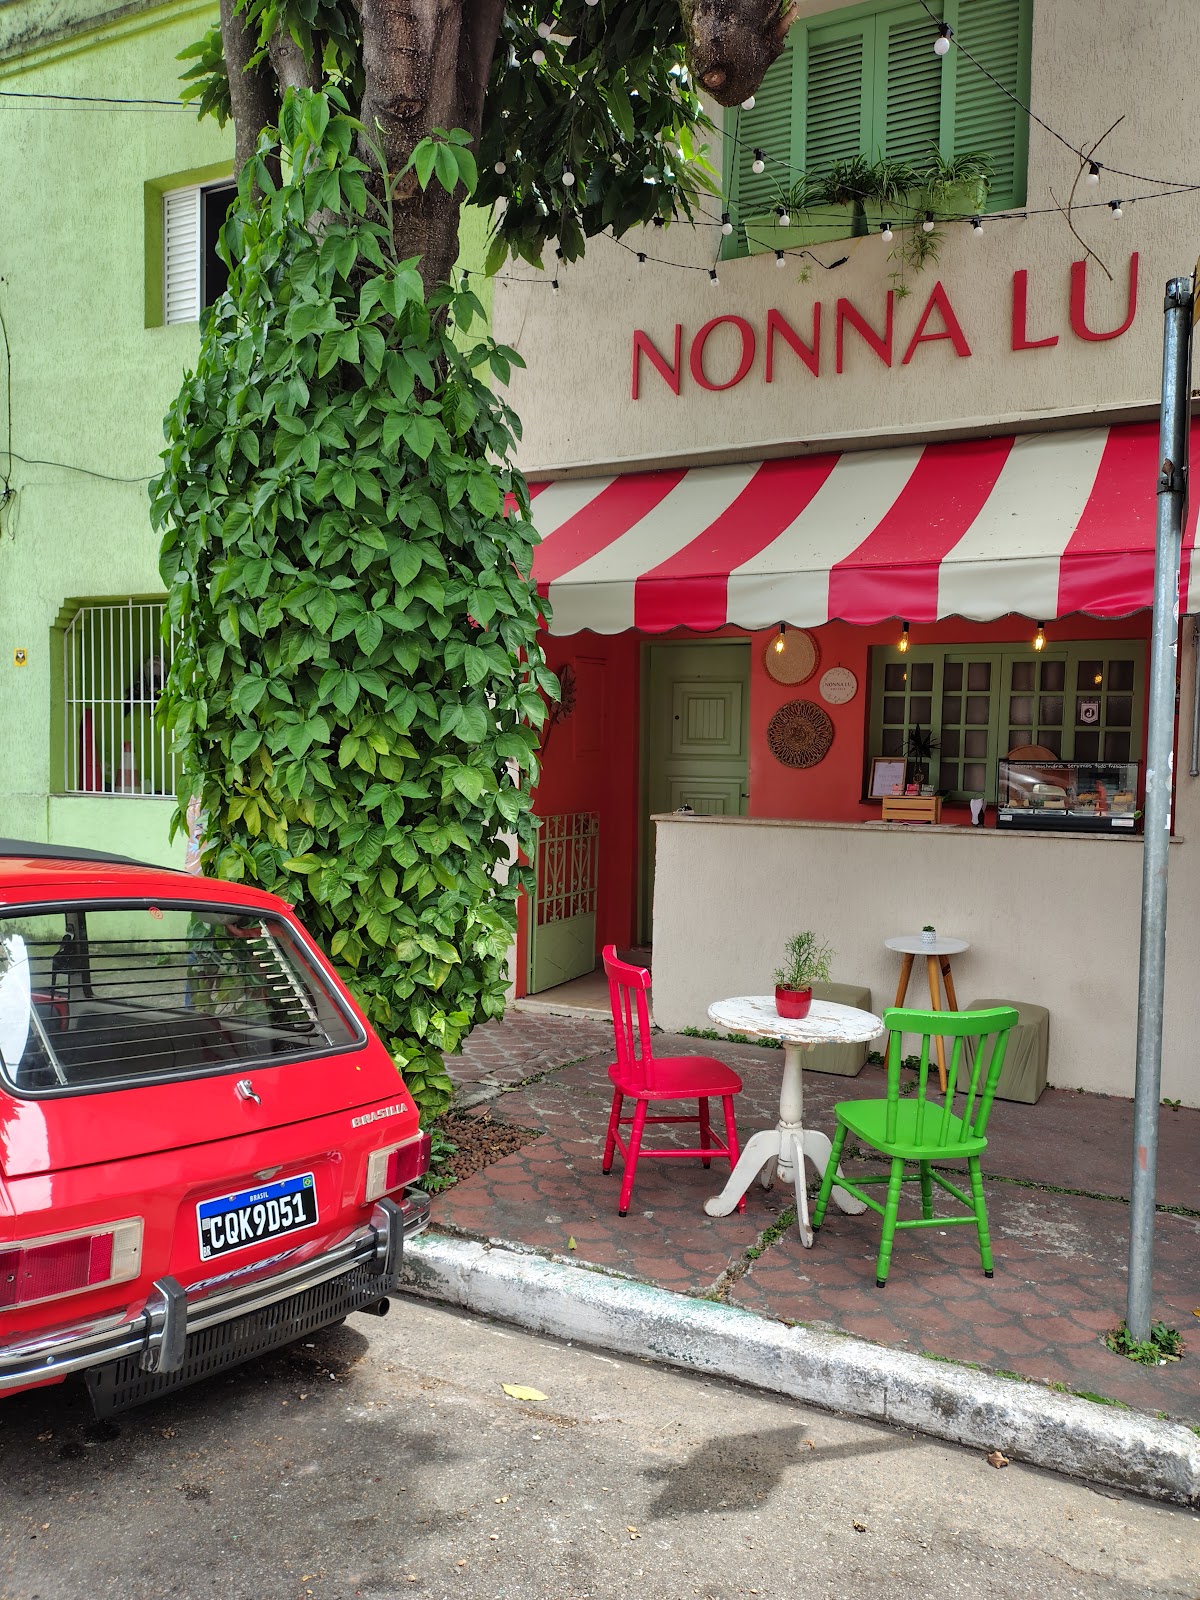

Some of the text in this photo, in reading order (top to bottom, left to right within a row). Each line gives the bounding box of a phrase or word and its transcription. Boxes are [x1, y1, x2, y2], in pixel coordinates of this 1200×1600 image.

[631, 251, 1139, 400] NONNA LU
[351, 1102, 408, 1128] BRASILIA
[249, 1191, 269, 1203] BRASIL
[210, 1192, 307, 1249] CQK9D51
[202, 1245, 211, 1258] BR
